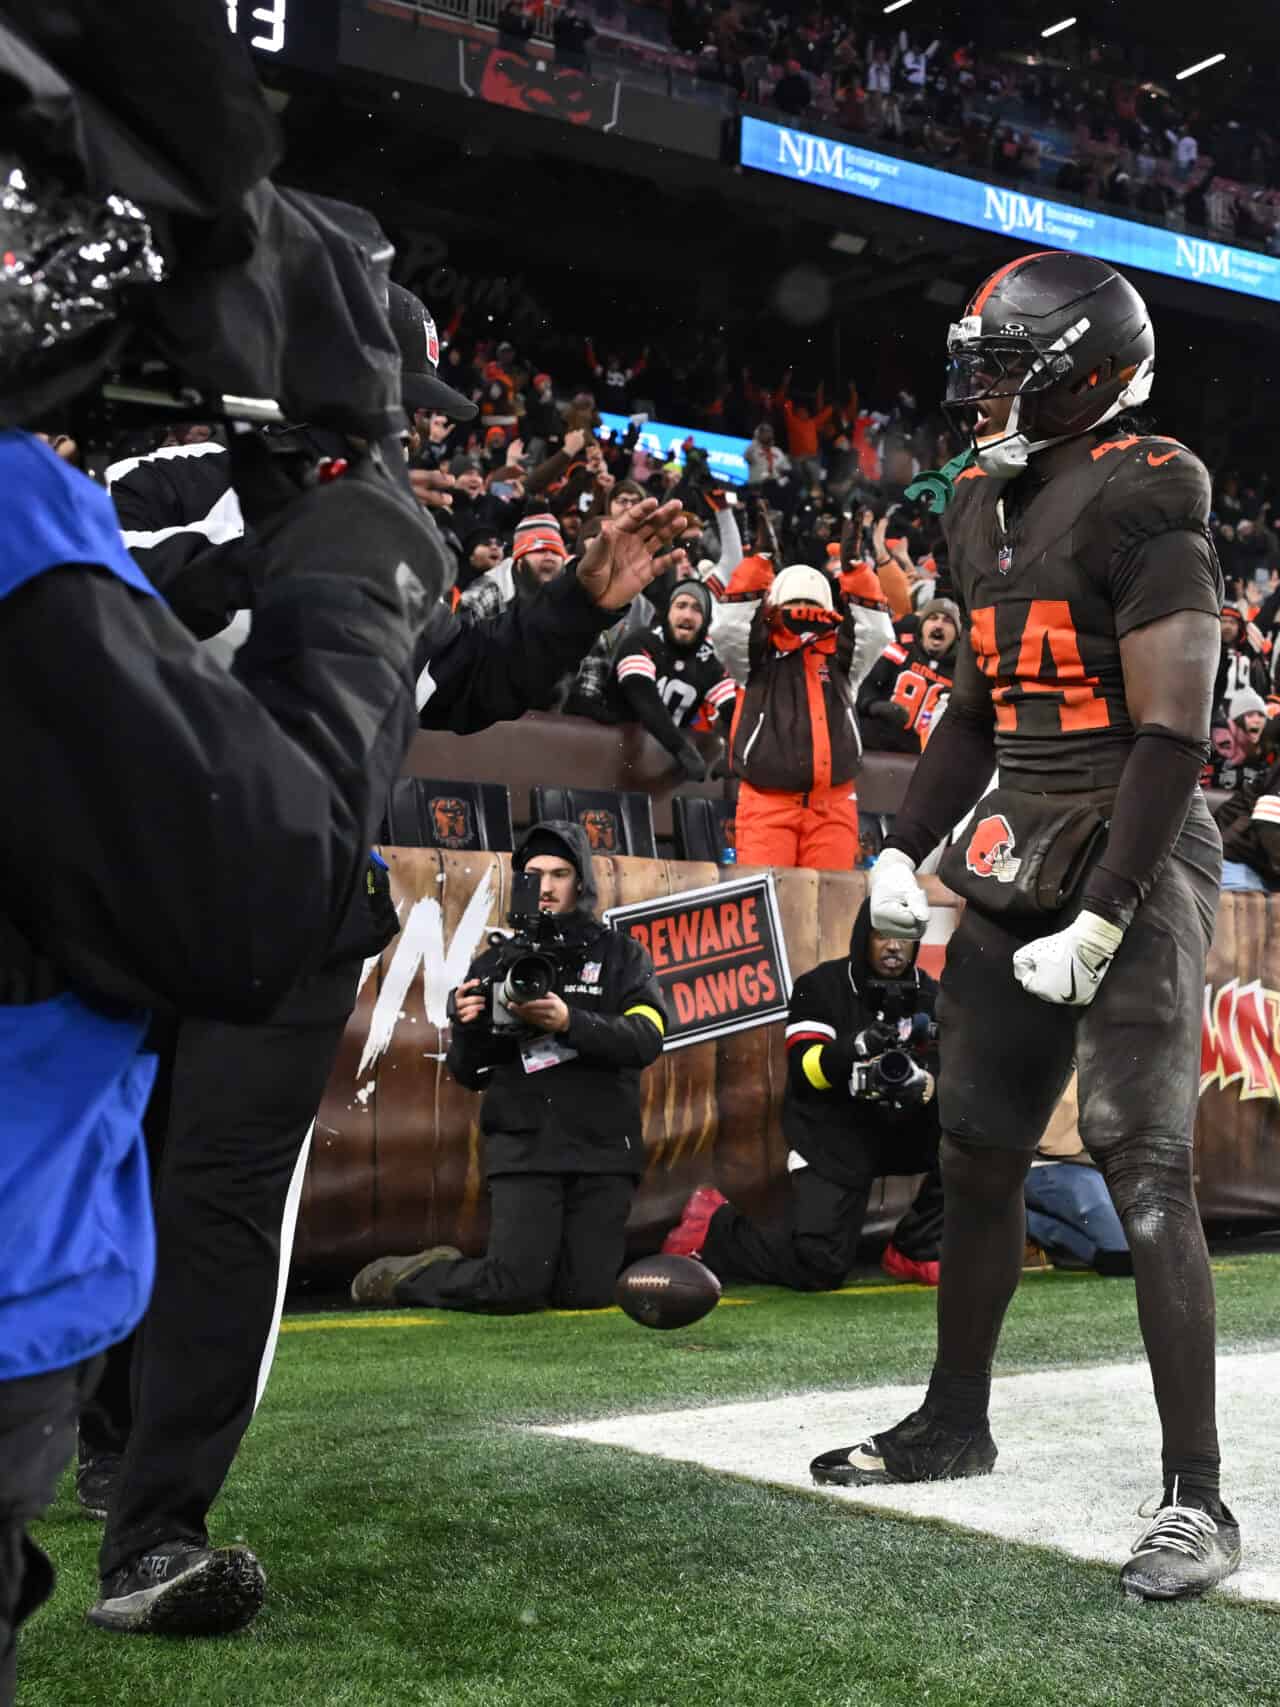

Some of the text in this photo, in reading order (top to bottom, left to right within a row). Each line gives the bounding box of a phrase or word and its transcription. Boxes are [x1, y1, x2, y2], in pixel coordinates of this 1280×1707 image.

[776, 129, 846, 178] NJM
[983, 185, 1046, 233] NJM
[1175, 236, 1232, 280] NJM
[671, 960, 777, 1025] DAWGS
